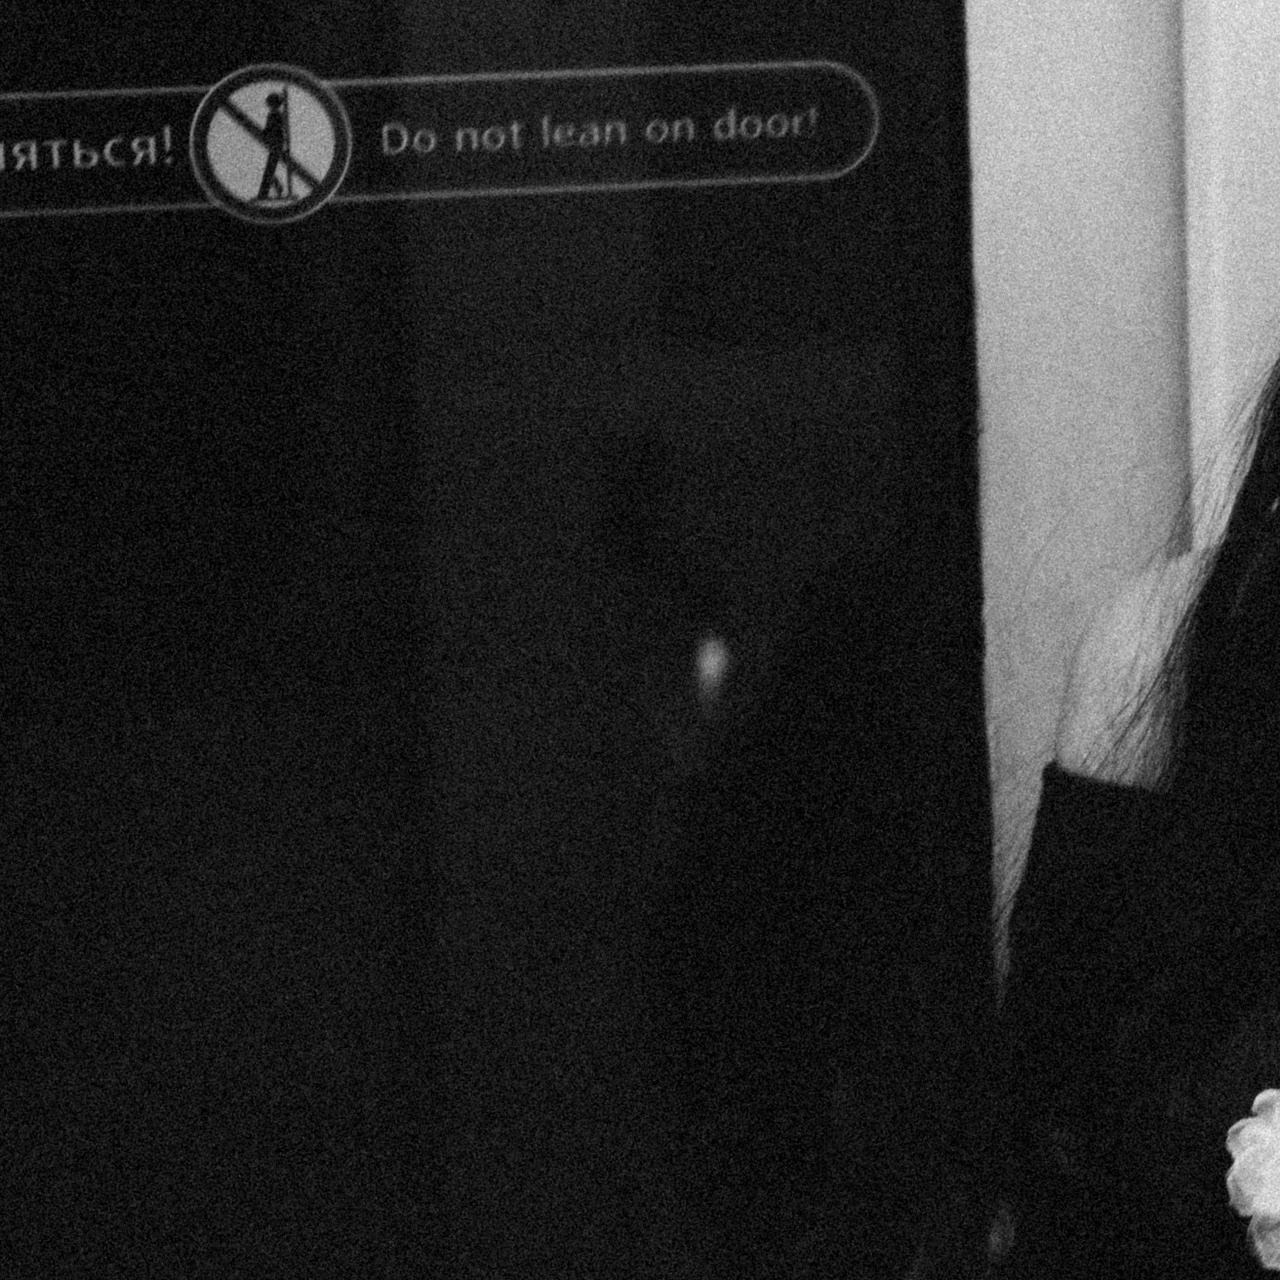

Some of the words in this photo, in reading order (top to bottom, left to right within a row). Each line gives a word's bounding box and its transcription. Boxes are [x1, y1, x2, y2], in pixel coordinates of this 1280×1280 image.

[0, 123, 173, 172] яться!
[380, 121, 438, 156] Do
[454, 119, 523, 153] not
[539, 114, 628, 149] lean
[644, 116, 696, 144] on
[711, 105, 818, 142] door!
